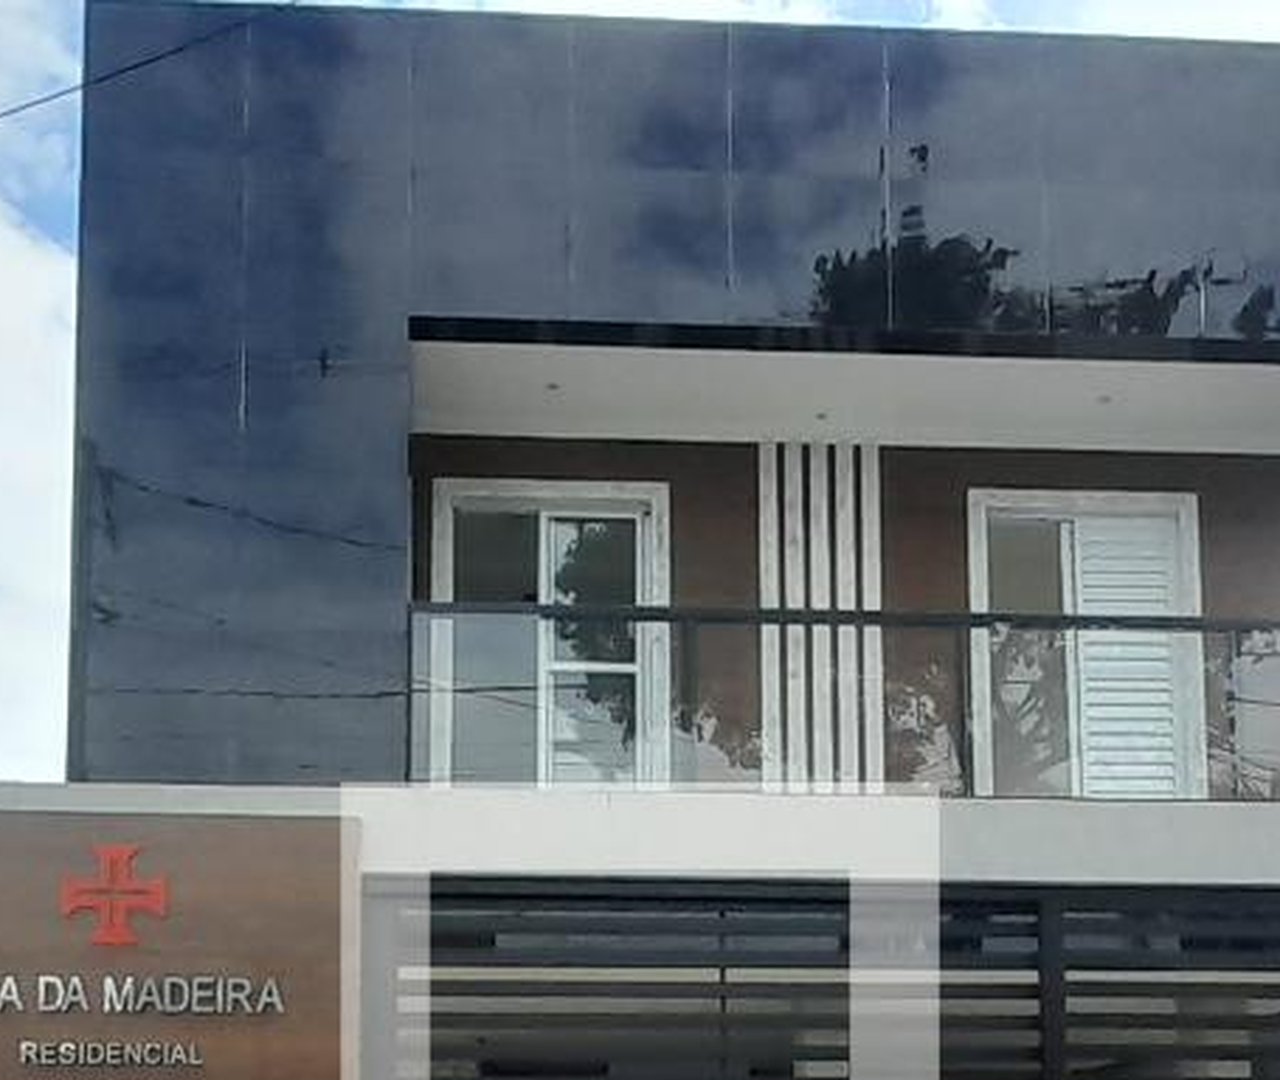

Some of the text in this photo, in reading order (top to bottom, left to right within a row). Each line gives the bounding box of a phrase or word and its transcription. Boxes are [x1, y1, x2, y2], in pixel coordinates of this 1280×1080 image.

[37, 975, 90, 1013] DA
[103, 976, 285, 1014] MADEIRA
[20, 1040, 205, 1066] RESIDENCIAL
